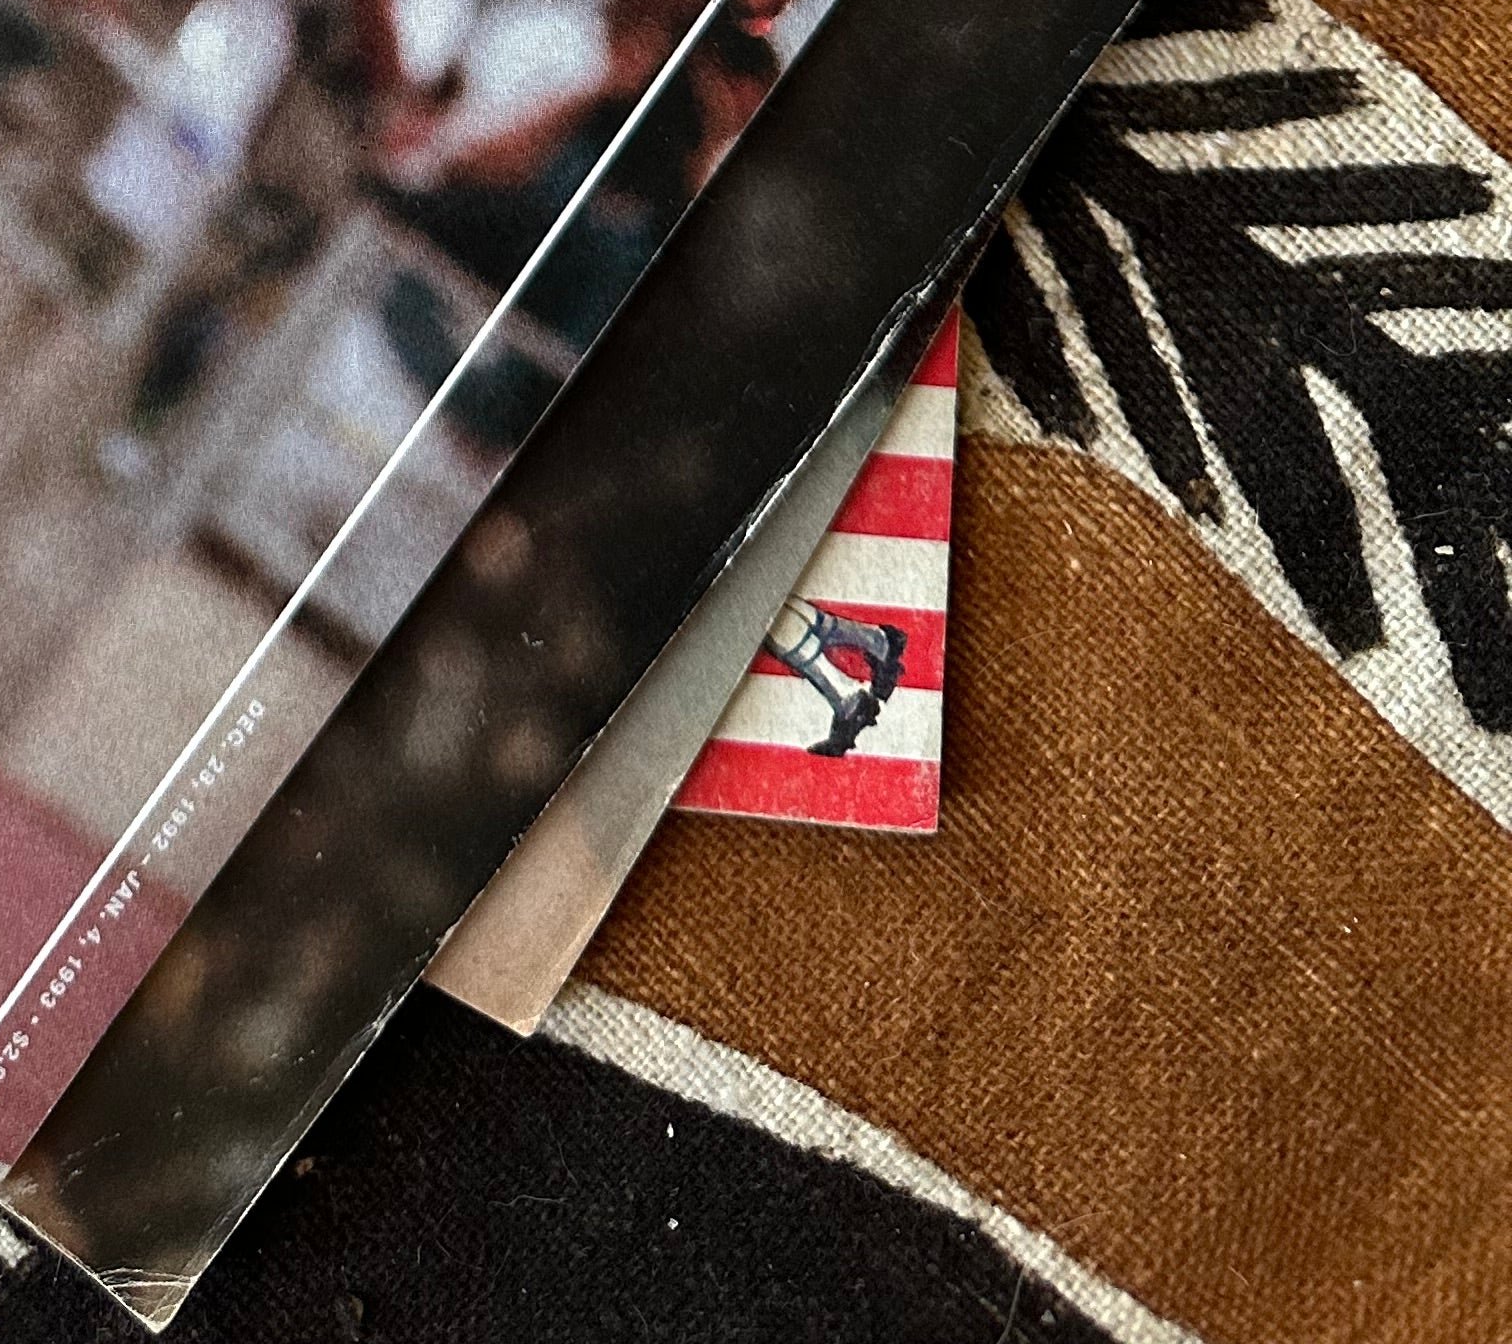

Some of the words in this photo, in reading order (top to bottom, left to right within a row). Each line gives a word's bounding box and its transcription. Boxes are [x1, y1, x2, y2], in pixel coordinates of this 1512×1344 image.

[222, 699, 266, 750] DEC.
[191, 754, 226, 789] 28,
[151, 797, 196, 852] 1992
[97, 869, 143, 923] JAN.
[77, 924, 103, 950] 4,
[40, 955, 84, 1009] 1993
